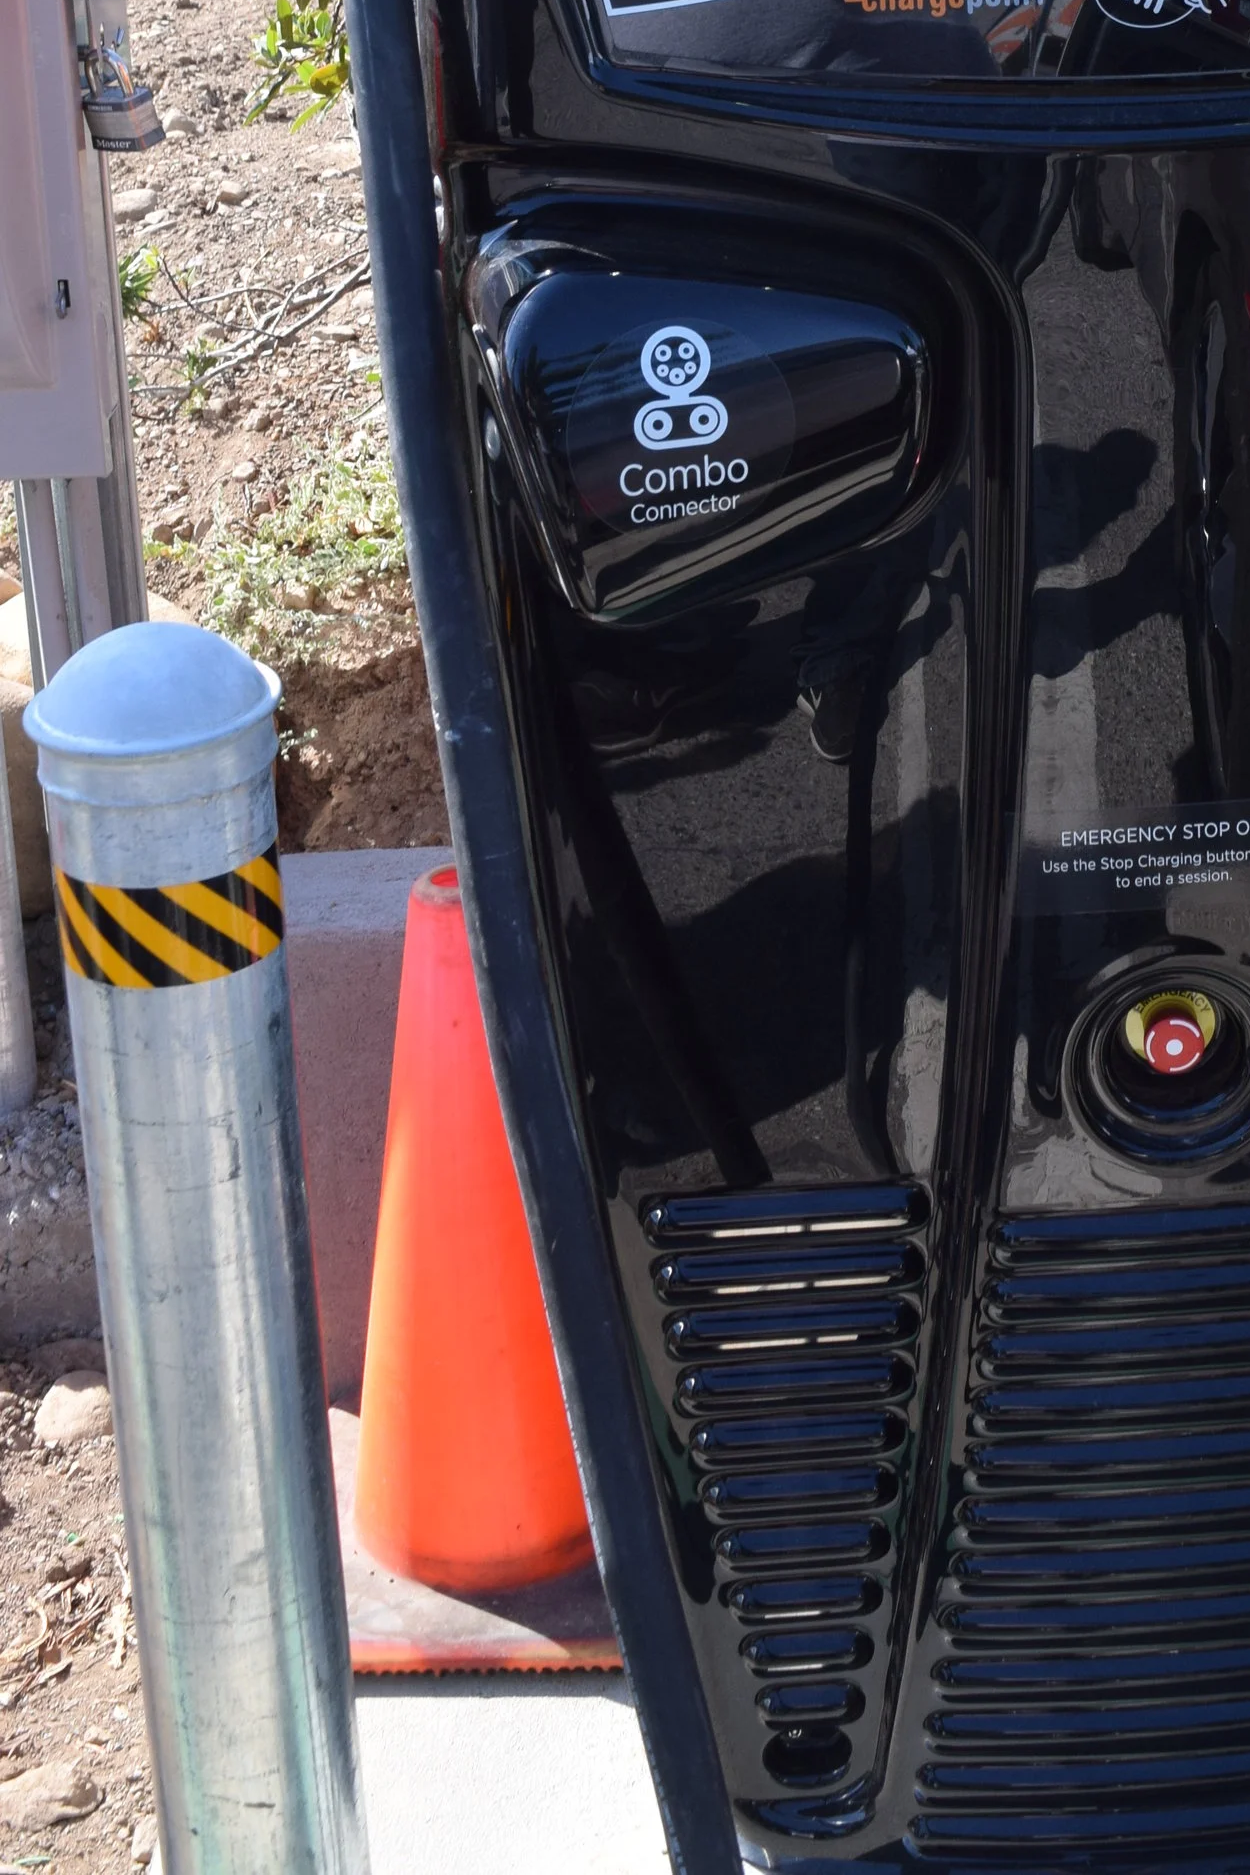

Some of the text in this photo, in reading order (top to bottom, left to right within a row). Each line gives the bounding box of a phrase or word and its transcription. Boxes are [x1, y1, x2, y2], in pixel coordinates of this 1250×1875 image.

[96, 138, 132, 149] Master
[619, 454, 749, 498] Combo
[630, 493, 740, 525] Connector
[1061, 825, 1177, 847] EMERGENCY
[1183, 821, 1231, 840] STOP
[1042, 860, 1069, 873] Use
[1073, 859, 1096, 872] the
[1100, 856, 1134, 871] Stop
[1137, 852, 1202, 868] Charging
[1115, 869, 1233, 888] to end a session.
